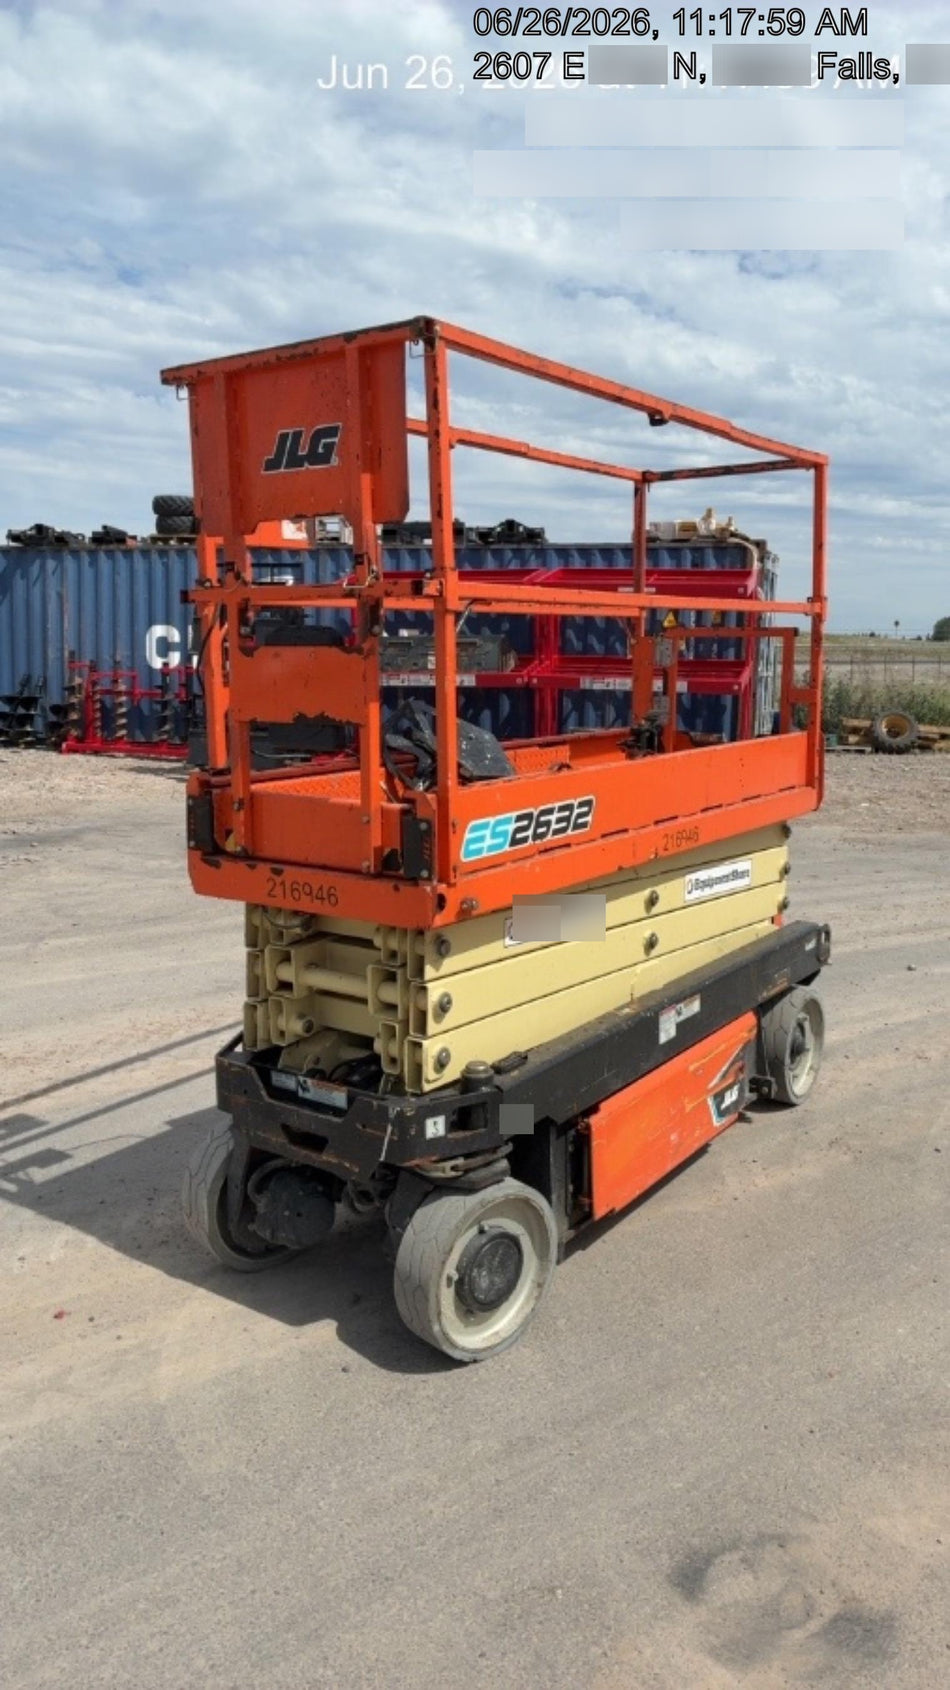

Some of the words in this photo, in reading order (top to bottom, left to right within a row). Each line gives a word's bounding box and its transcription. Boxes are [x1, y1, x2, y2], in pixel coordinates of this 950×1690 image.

[262, 423, 342, 473] JLG
[461, 795, 596, 862] ES2632
[266, 877, 339, 907] 216946
